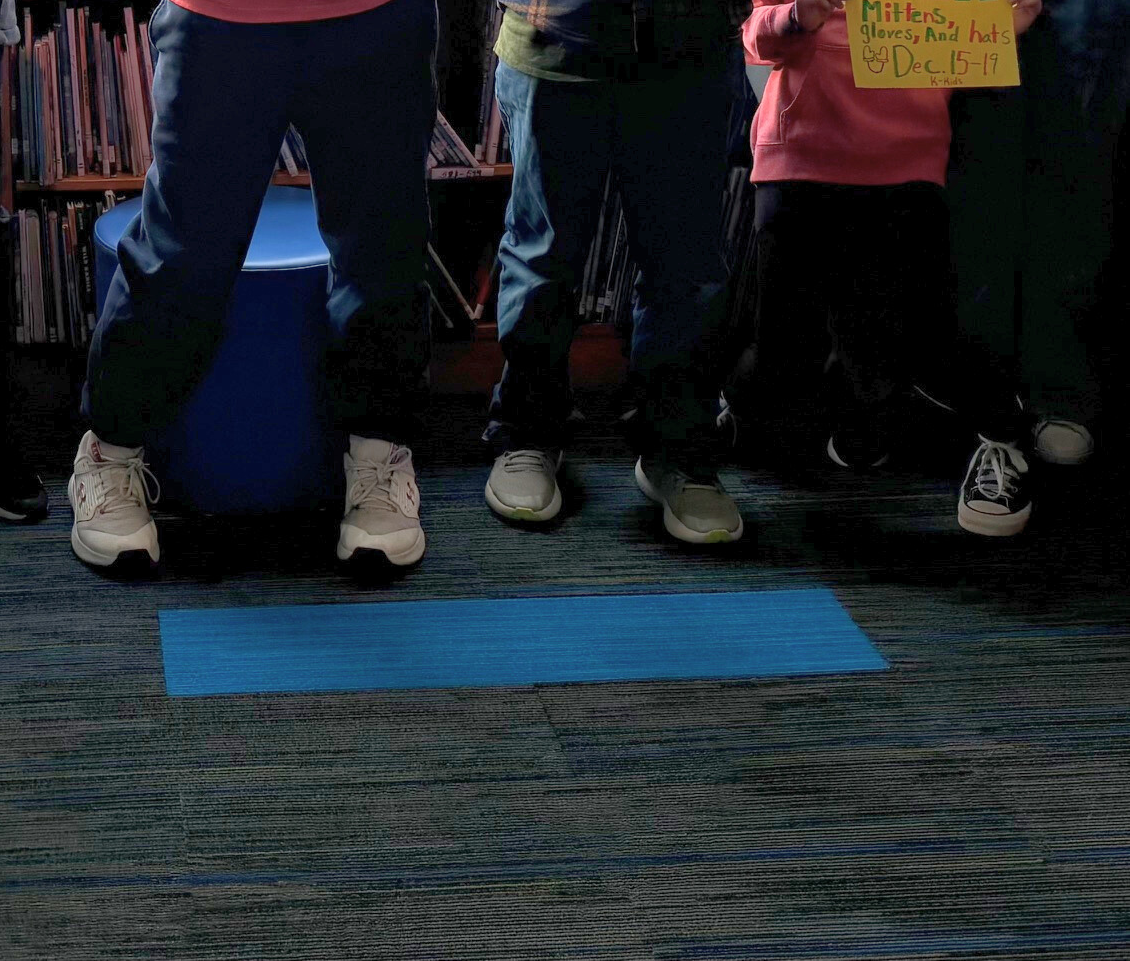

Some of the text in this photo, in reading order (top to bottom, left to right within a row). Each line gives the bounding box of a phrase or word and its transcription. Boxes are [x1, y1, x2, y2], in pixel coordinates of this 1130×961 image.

[860, 19, 1011, 45] gloves, And hats
[892, 44, 998, 78] Dec. 15-19
[930, 75, 963, 86] K-Kids
